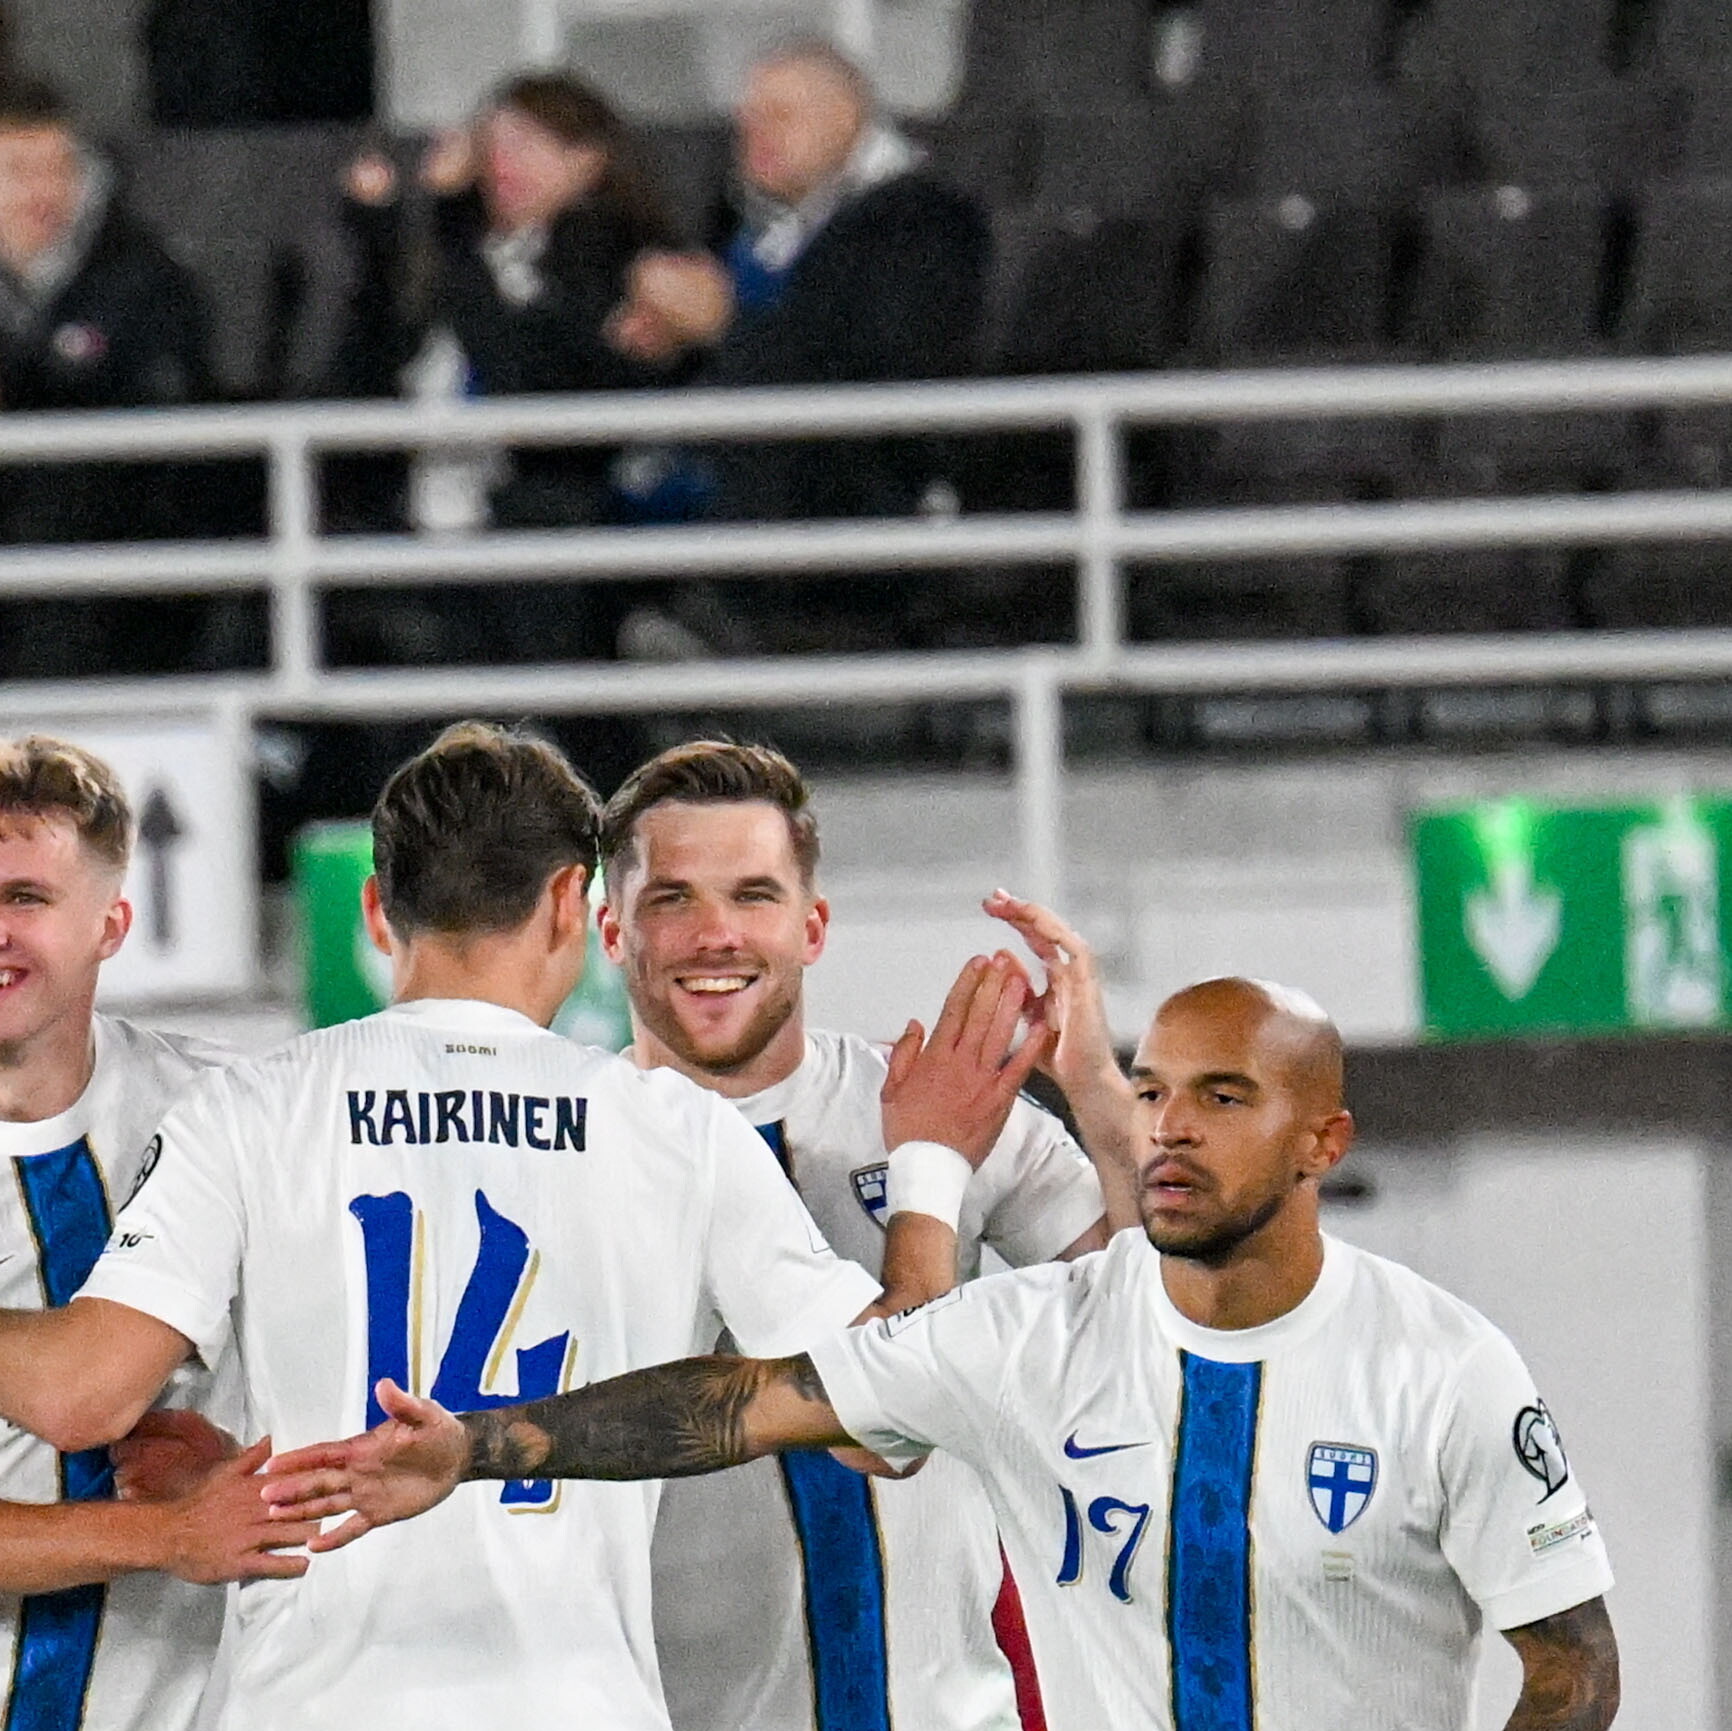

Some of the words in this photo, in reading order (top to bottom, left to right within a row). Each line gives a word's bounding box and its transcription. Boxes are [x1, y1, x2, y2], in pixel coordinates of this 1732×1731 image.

[347, 1090, 588, 1153] KAIRINEN
[348, 1188, 580, 1515] 14
[1055, 1483, 1152, 1605] 17
